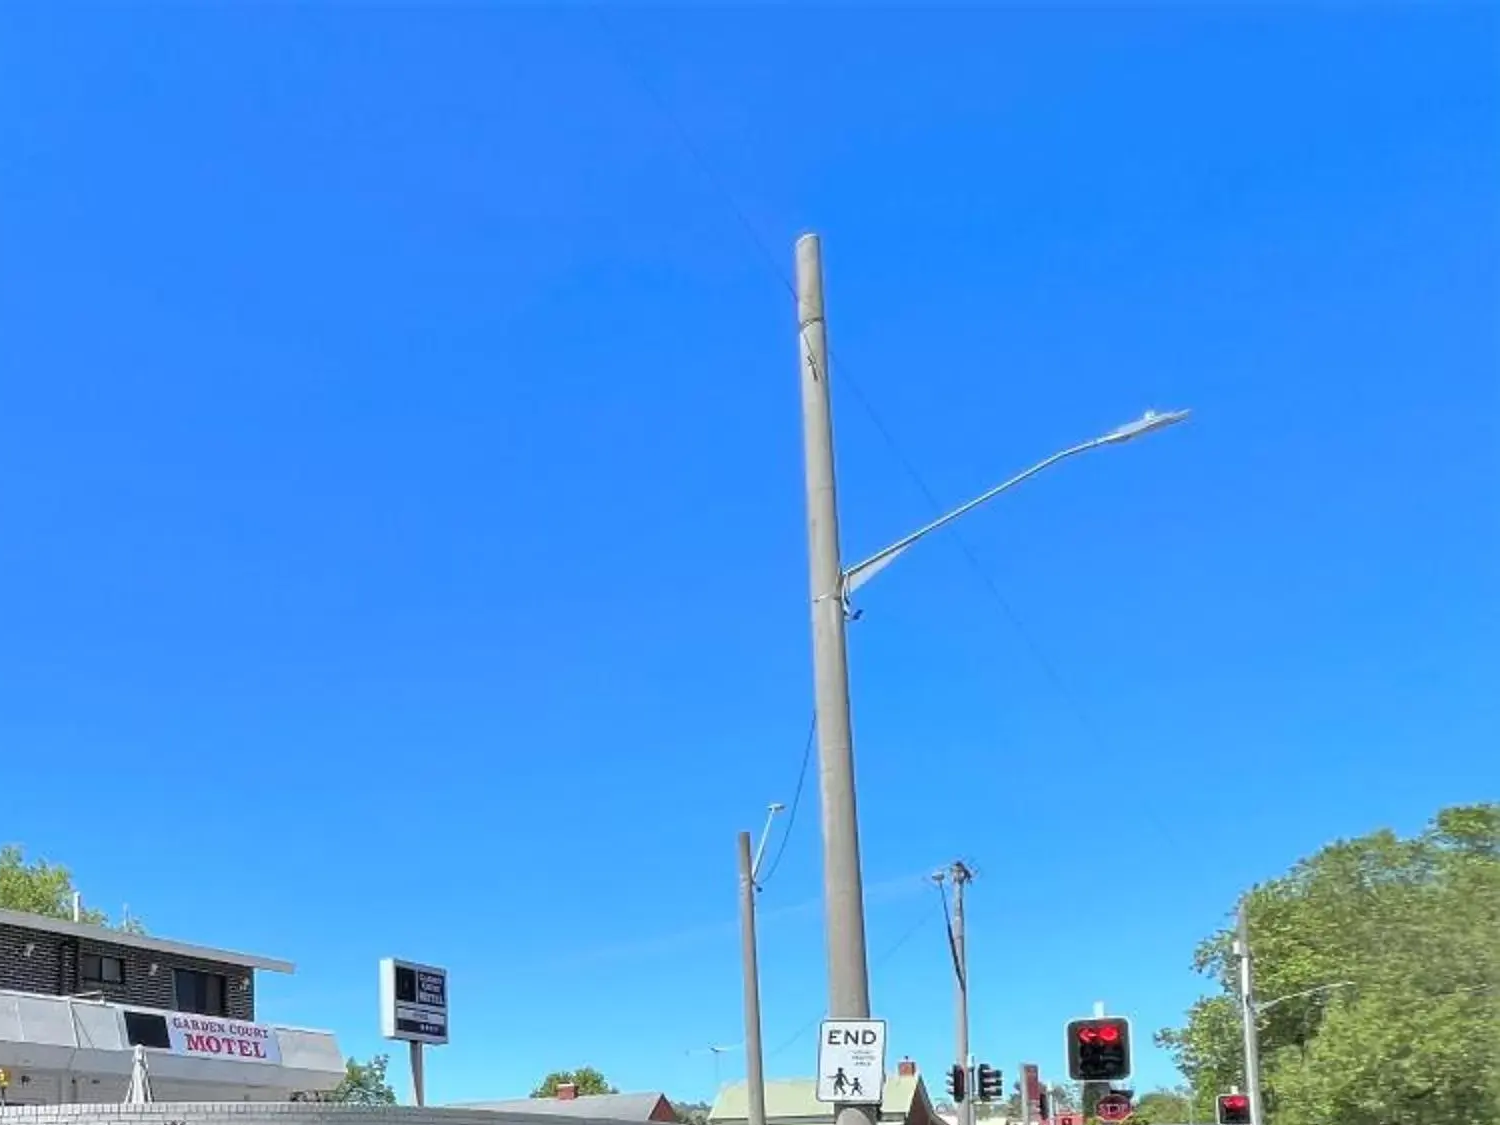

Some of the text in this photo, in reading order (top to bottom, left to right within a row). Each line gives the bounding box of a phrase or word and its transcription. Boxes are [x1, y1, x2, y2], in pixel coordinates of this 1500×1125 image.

[173, 1016, 268, 1039] GARDEN COURT
[828, 1029, 877, 1045] END
[185, 1033, 267, 1059] MOTEL
